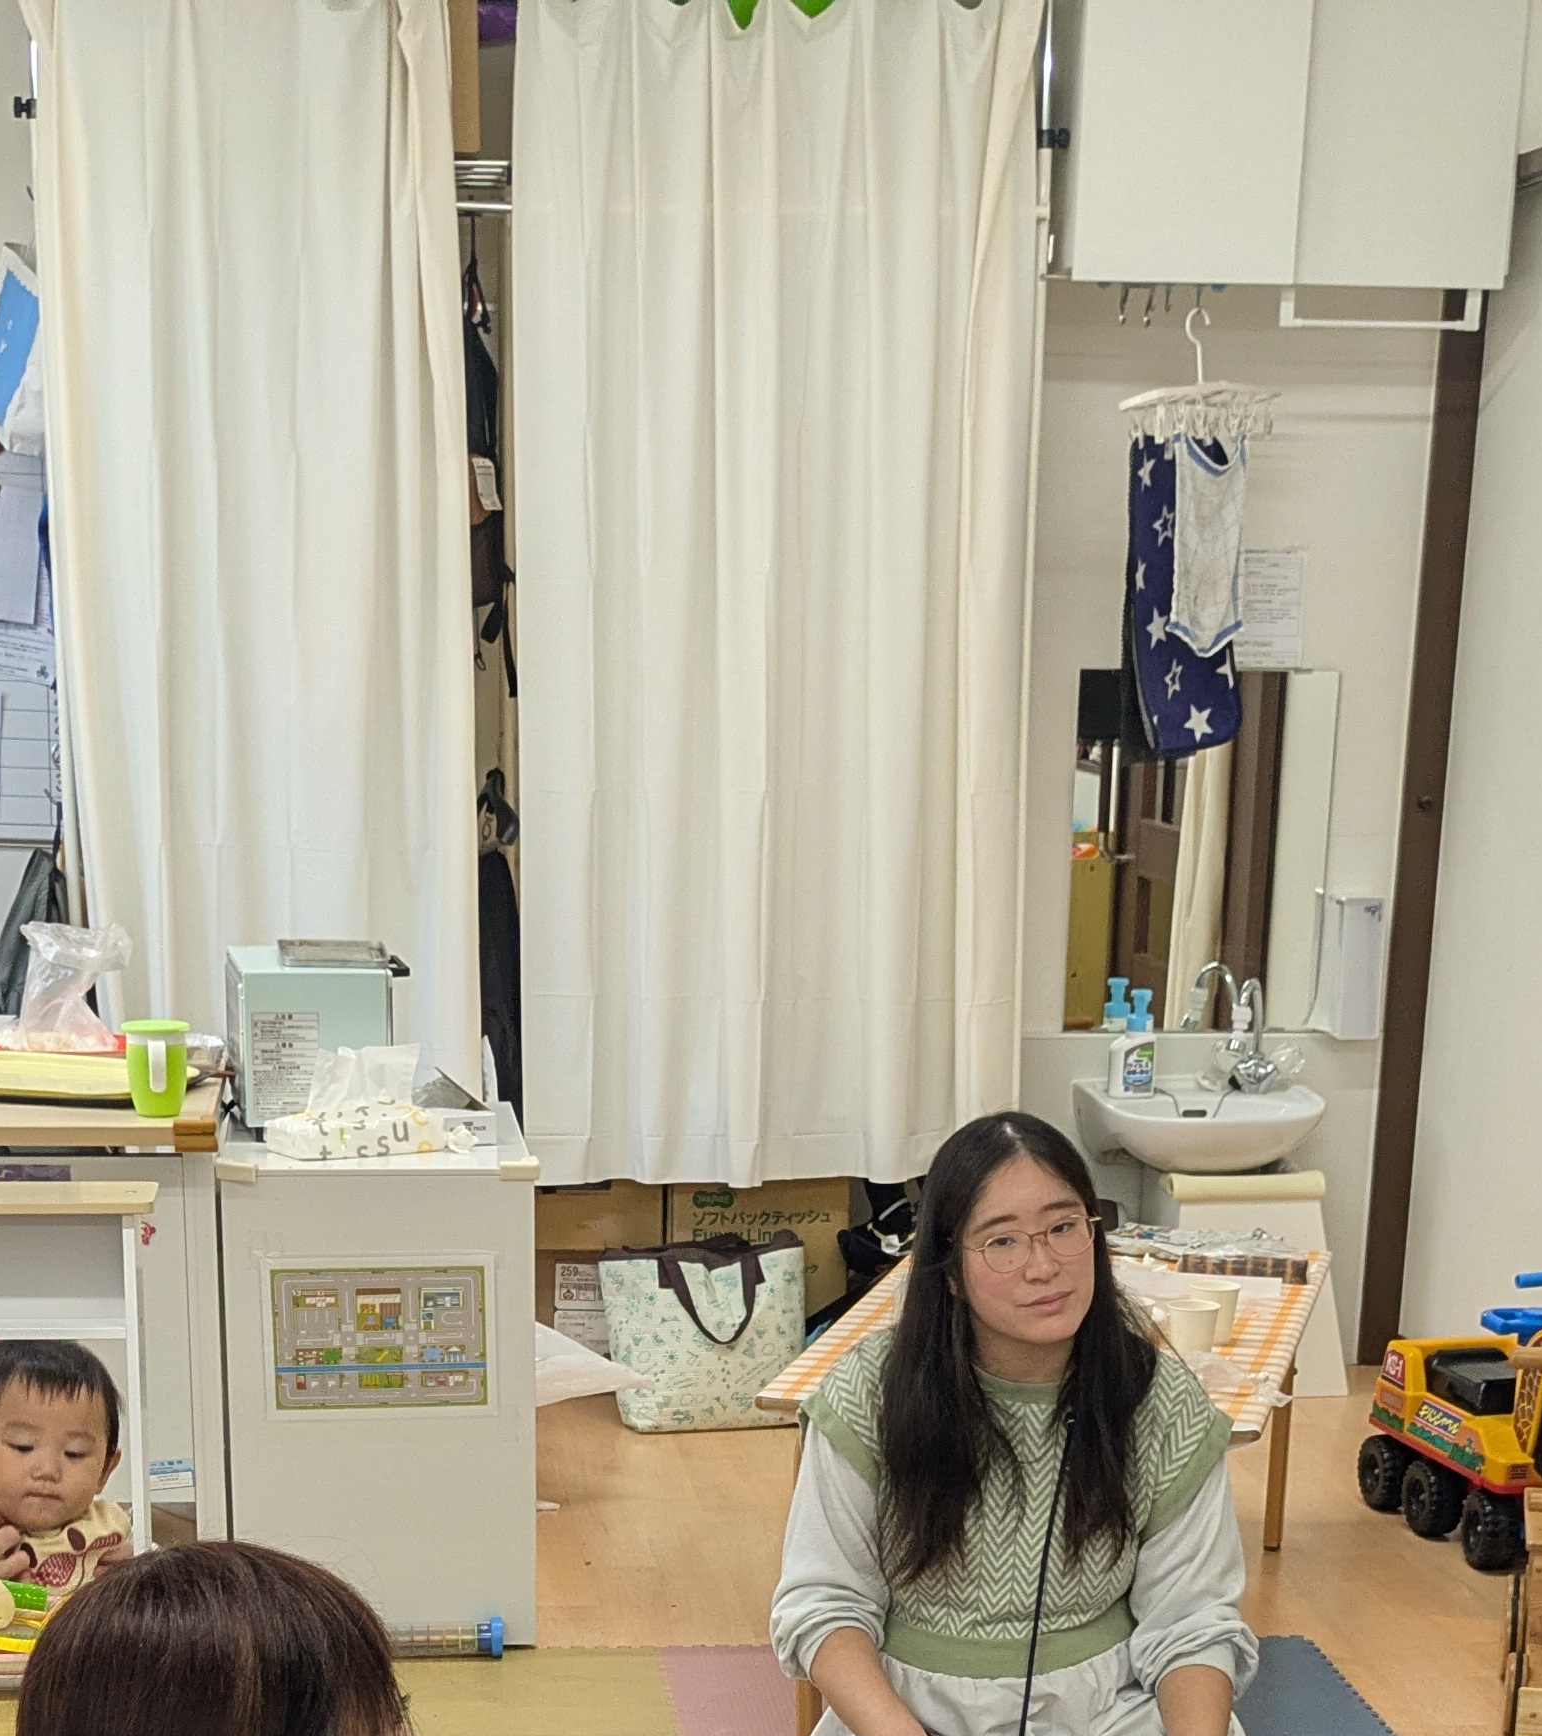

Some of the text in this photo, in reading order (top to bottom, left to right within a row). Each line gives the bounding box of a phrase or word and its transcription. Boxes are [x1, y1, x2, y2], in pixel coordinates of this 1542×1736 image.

[692, 1210, 832, 1226] ソフトパックティッシュ
[560, 1266, 579, 1277] 259
